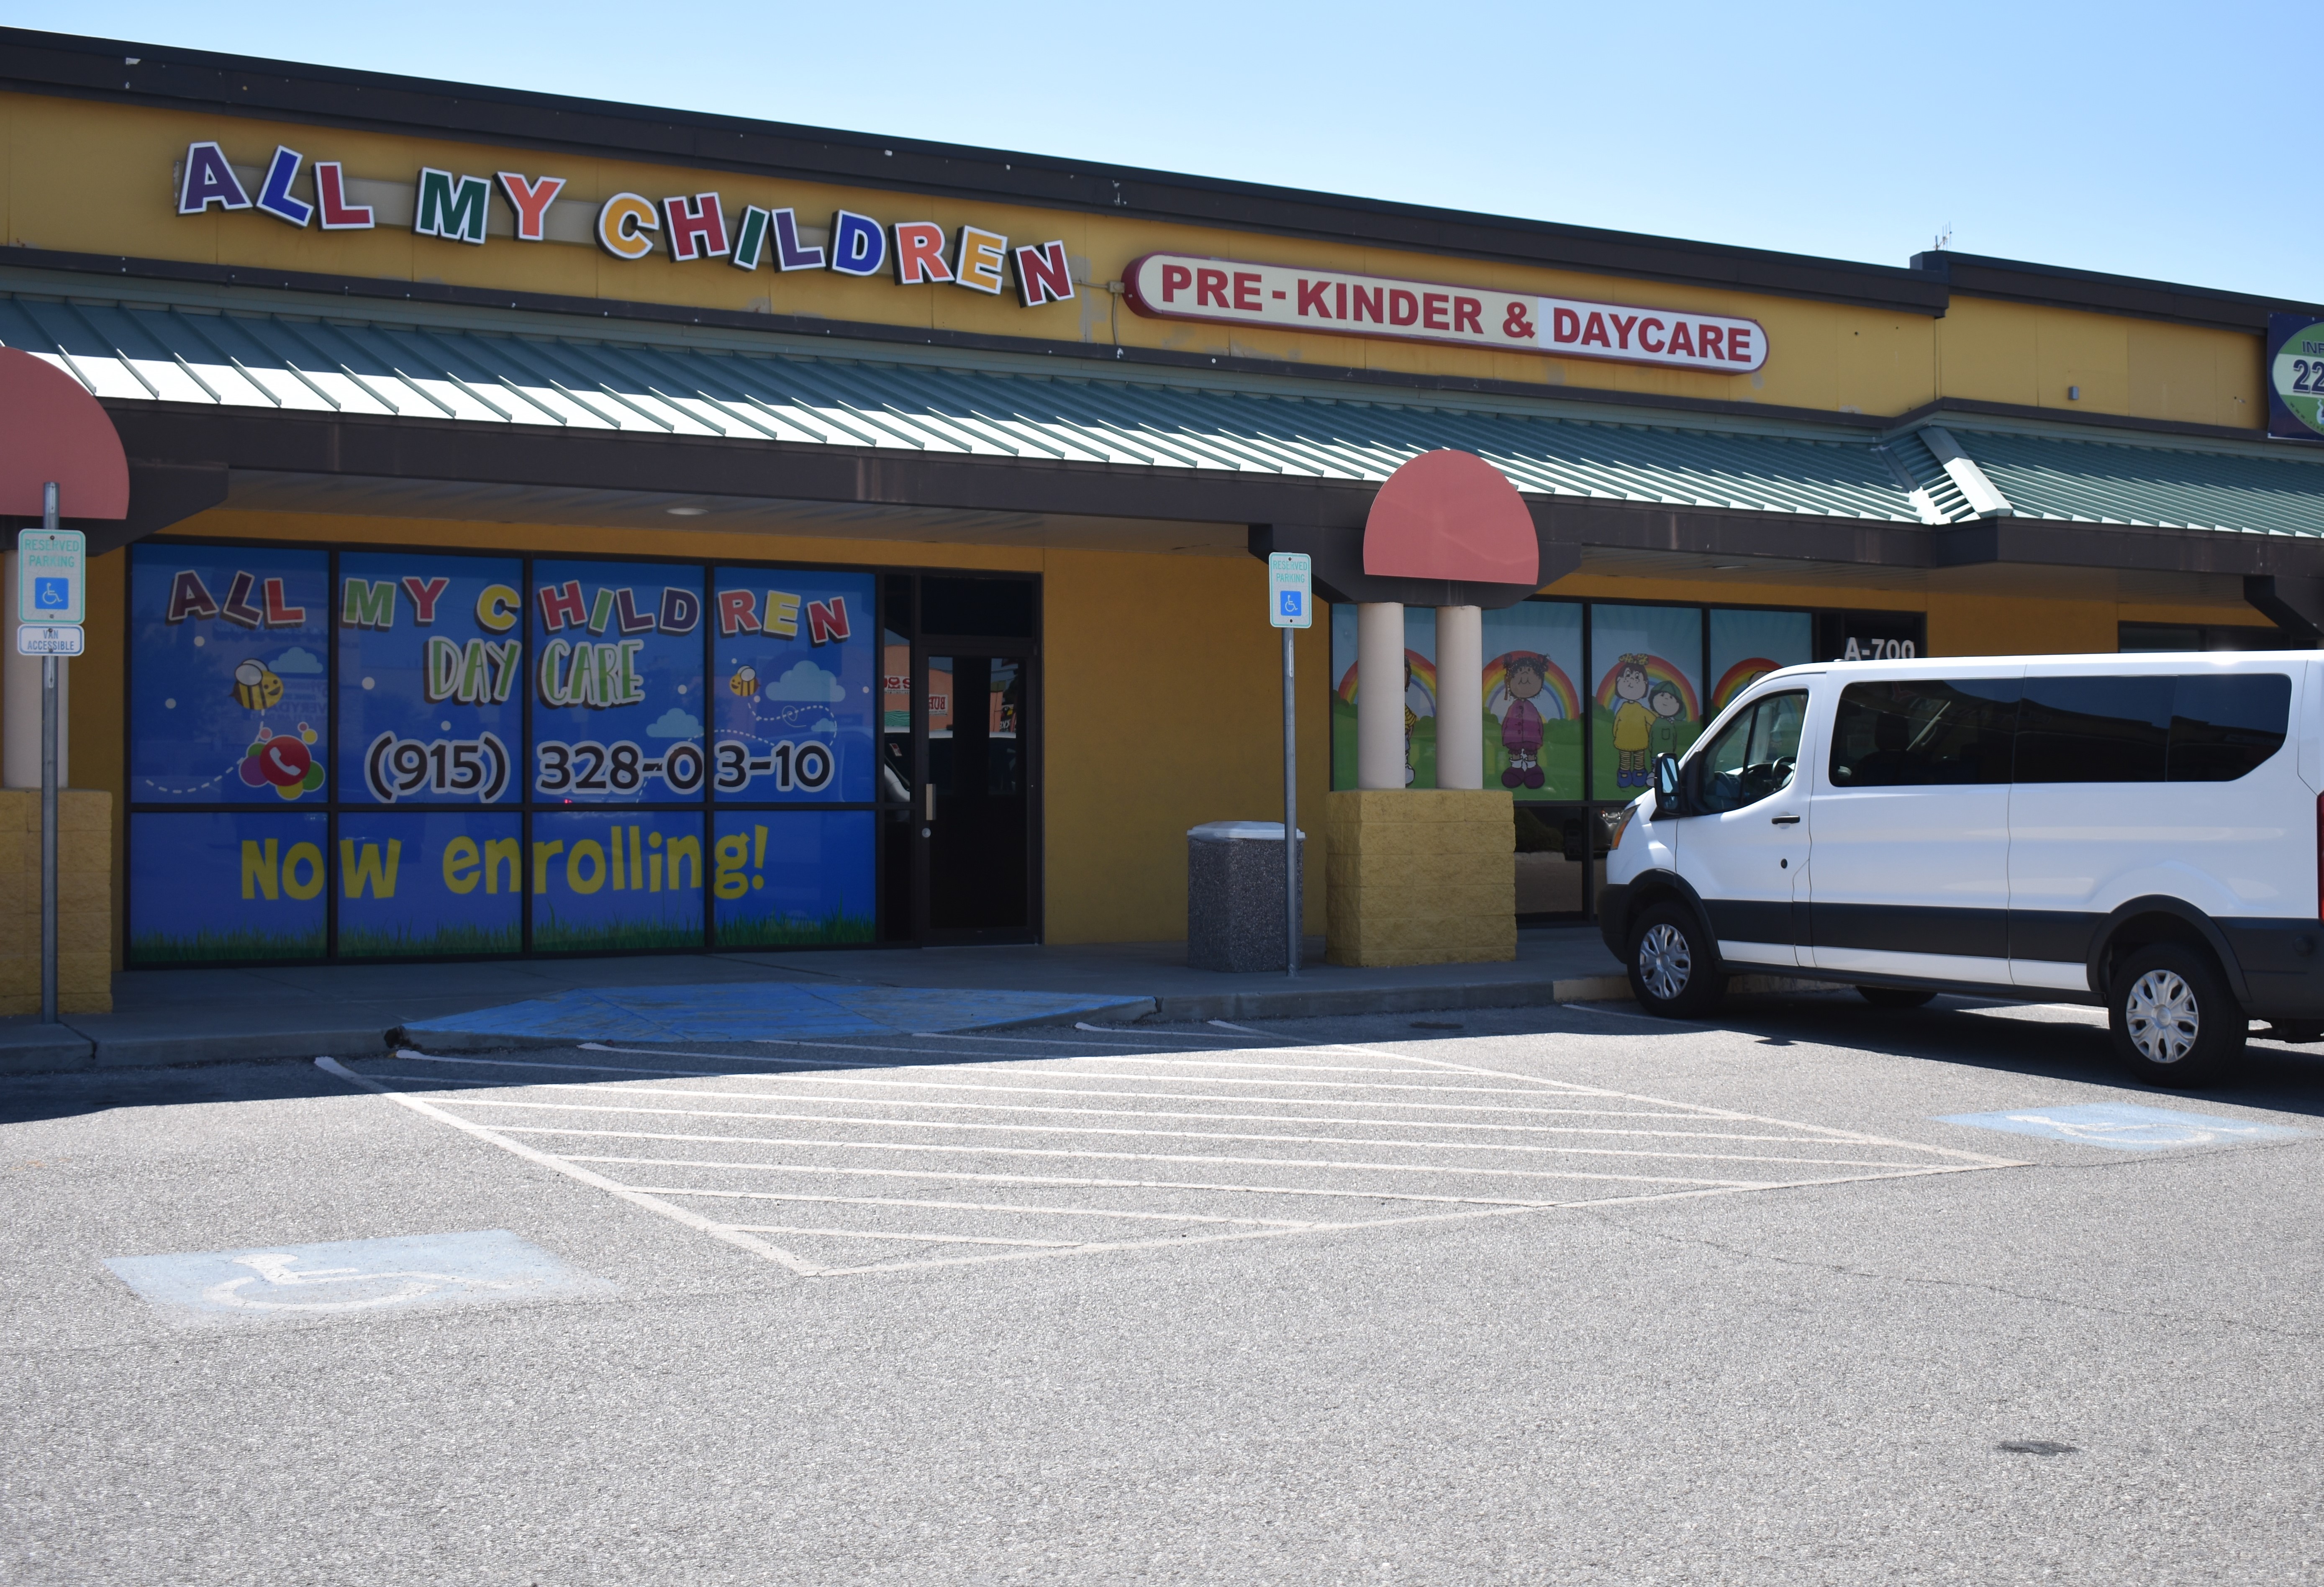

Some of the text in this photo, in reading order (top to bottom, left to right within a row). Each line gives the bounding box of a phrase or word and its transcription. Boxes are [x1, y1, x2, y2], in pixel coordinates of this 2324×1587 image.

[177, 141, 1075, 308] ALL MY CHILDREN
[1161, 264, 1752, 363] PRE-KINDER & DAYCARE
[24, 539, 79, 551] RESERVED
[29, 555, 74, 567] PARKING
[1273, 561, 1308, 570] RESERVED
[1276, 573, 1305, 583] PARKING
[167, 569, 306, 626] ALL
[342, 577, 450, 628] MY
[43, 630, 59, 639] VAN
[27, 641, 74, 651] ACCESSIBLE
[1844, 637, 1915, 661] A-700
[428, 636, 645, 708] DAY CARE
[364, 731, 510, 803] (915)
